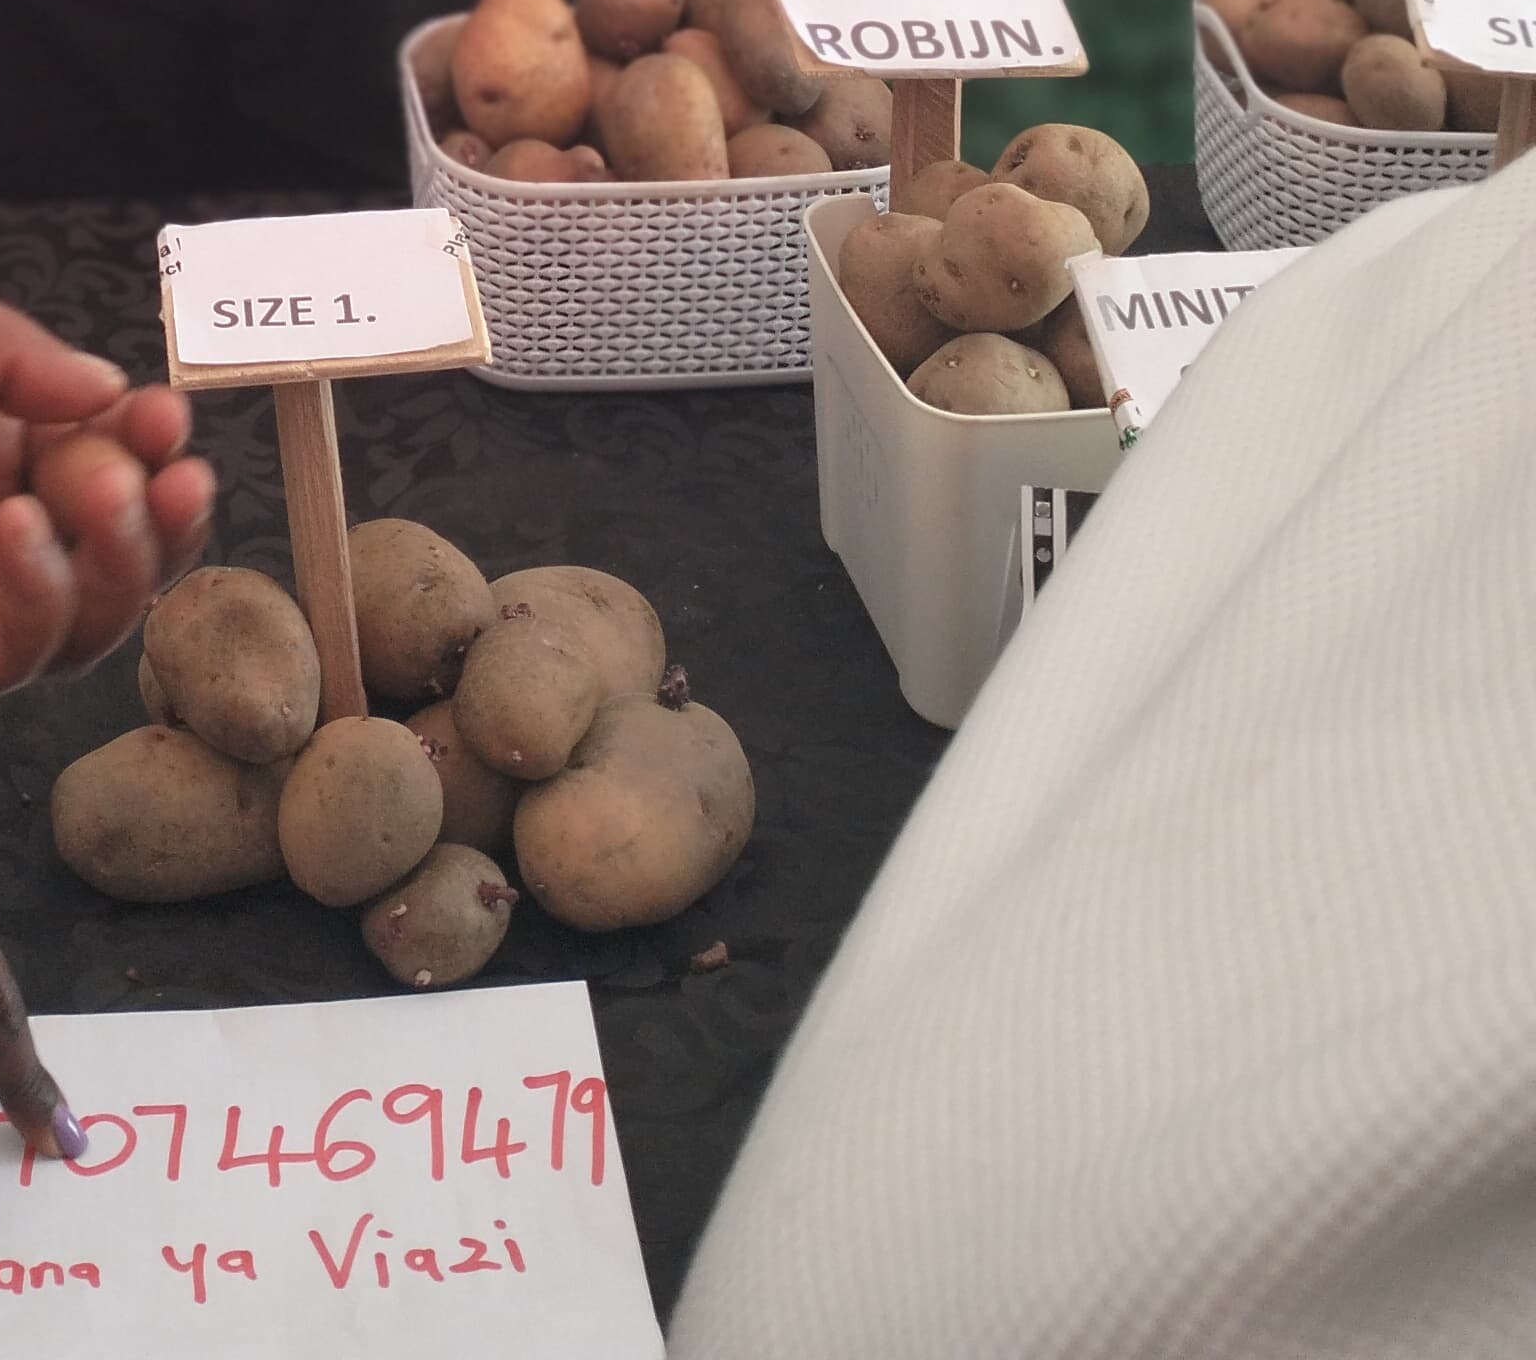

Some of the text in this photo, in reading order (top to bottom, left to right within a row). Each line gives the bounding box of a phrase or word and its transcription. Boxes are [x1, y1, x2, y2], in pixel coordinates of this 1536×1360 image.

[805, 18, 1065, 61] ROBIJN.
[1487, 16, 1536, 49] SI
[213, 293, 377, 329] SIZE 1.
[161, 1242, 259, 1304] ya
[308, 1212, 527, 1290] Viazi
